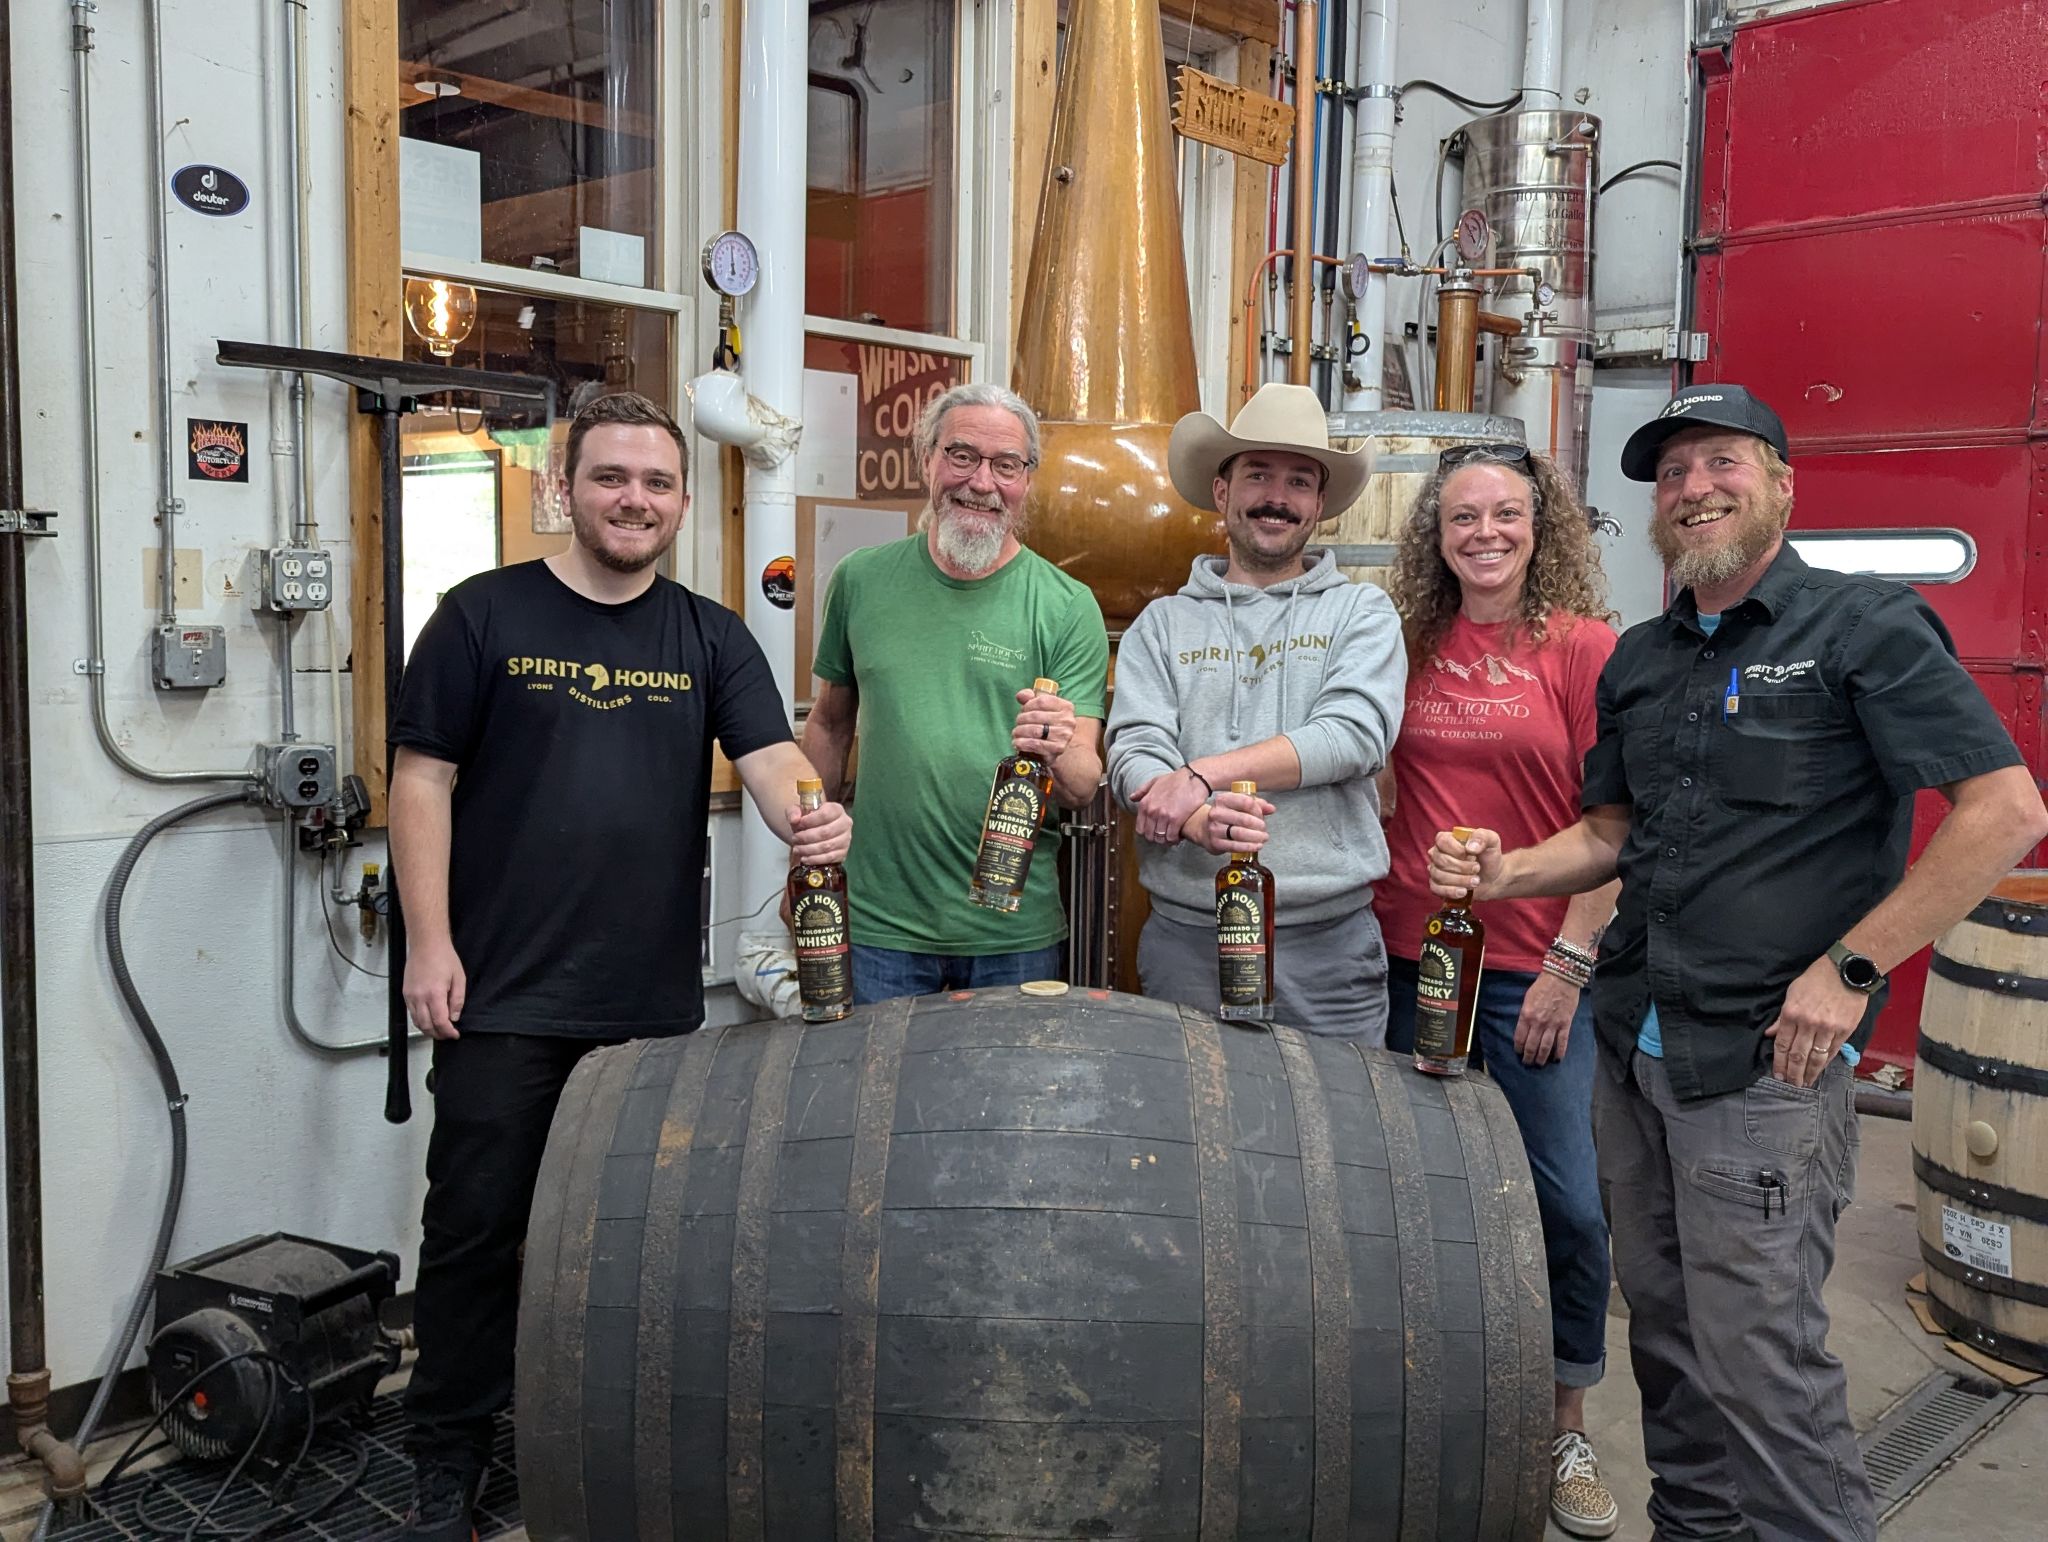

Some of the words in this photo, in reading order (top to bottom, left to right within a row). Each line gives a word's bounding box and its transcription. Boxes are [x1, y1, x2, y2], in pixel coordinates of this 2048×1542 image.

[1195, 79, 1247, 142] STILL
[193, 191, 229, 205] deuter
[1516, 192, 1538, 201] HOT
[1545, 191, 1579, 202] WATER
[1545, 208, 1558, 219] 40
[1683, 395, 1723, 405] HOUND
[196, 453, 240, 465] MOTORCYCLE
[1178, 646, 1245, 665] SPIRIT
[507, 657, 582, 680] SPIRIT
[614, 669, 692, 691] HOUND
[527, 683, 554, 691] LYONS
[568, 686, 633, 710] DISTILLERS
[1406, 700, 1453, 717] PIRIT
[1457, 702, 1530, 719] HOUND
[1425, 715, 1487, 725] DISTILLERS
[1441, 730, 1503, 740] COLORADO
[992, 783, 1015, 811] SPIRIT
[1018, 783, 1039, 820] HOUND
[997, 814, 1028, 826] COLORADO
[988, 820, 1033, 839] WHISKY
[794, 896, 811, 927] SPIRIT
[814, 894, 843, 924] HOUND
[1231, 891, 1260, 924] HOUND
[803, 927, 835, 935] COLORADO
[1218, 932, 1260, 944] WHISKY
[797, 933, 843, 947] WHISKY
[1429, 943, 1455, 980] HOUND
[1989, 1224, 1995, 1232] F
[1998, 1226, 2005, 1234] X
